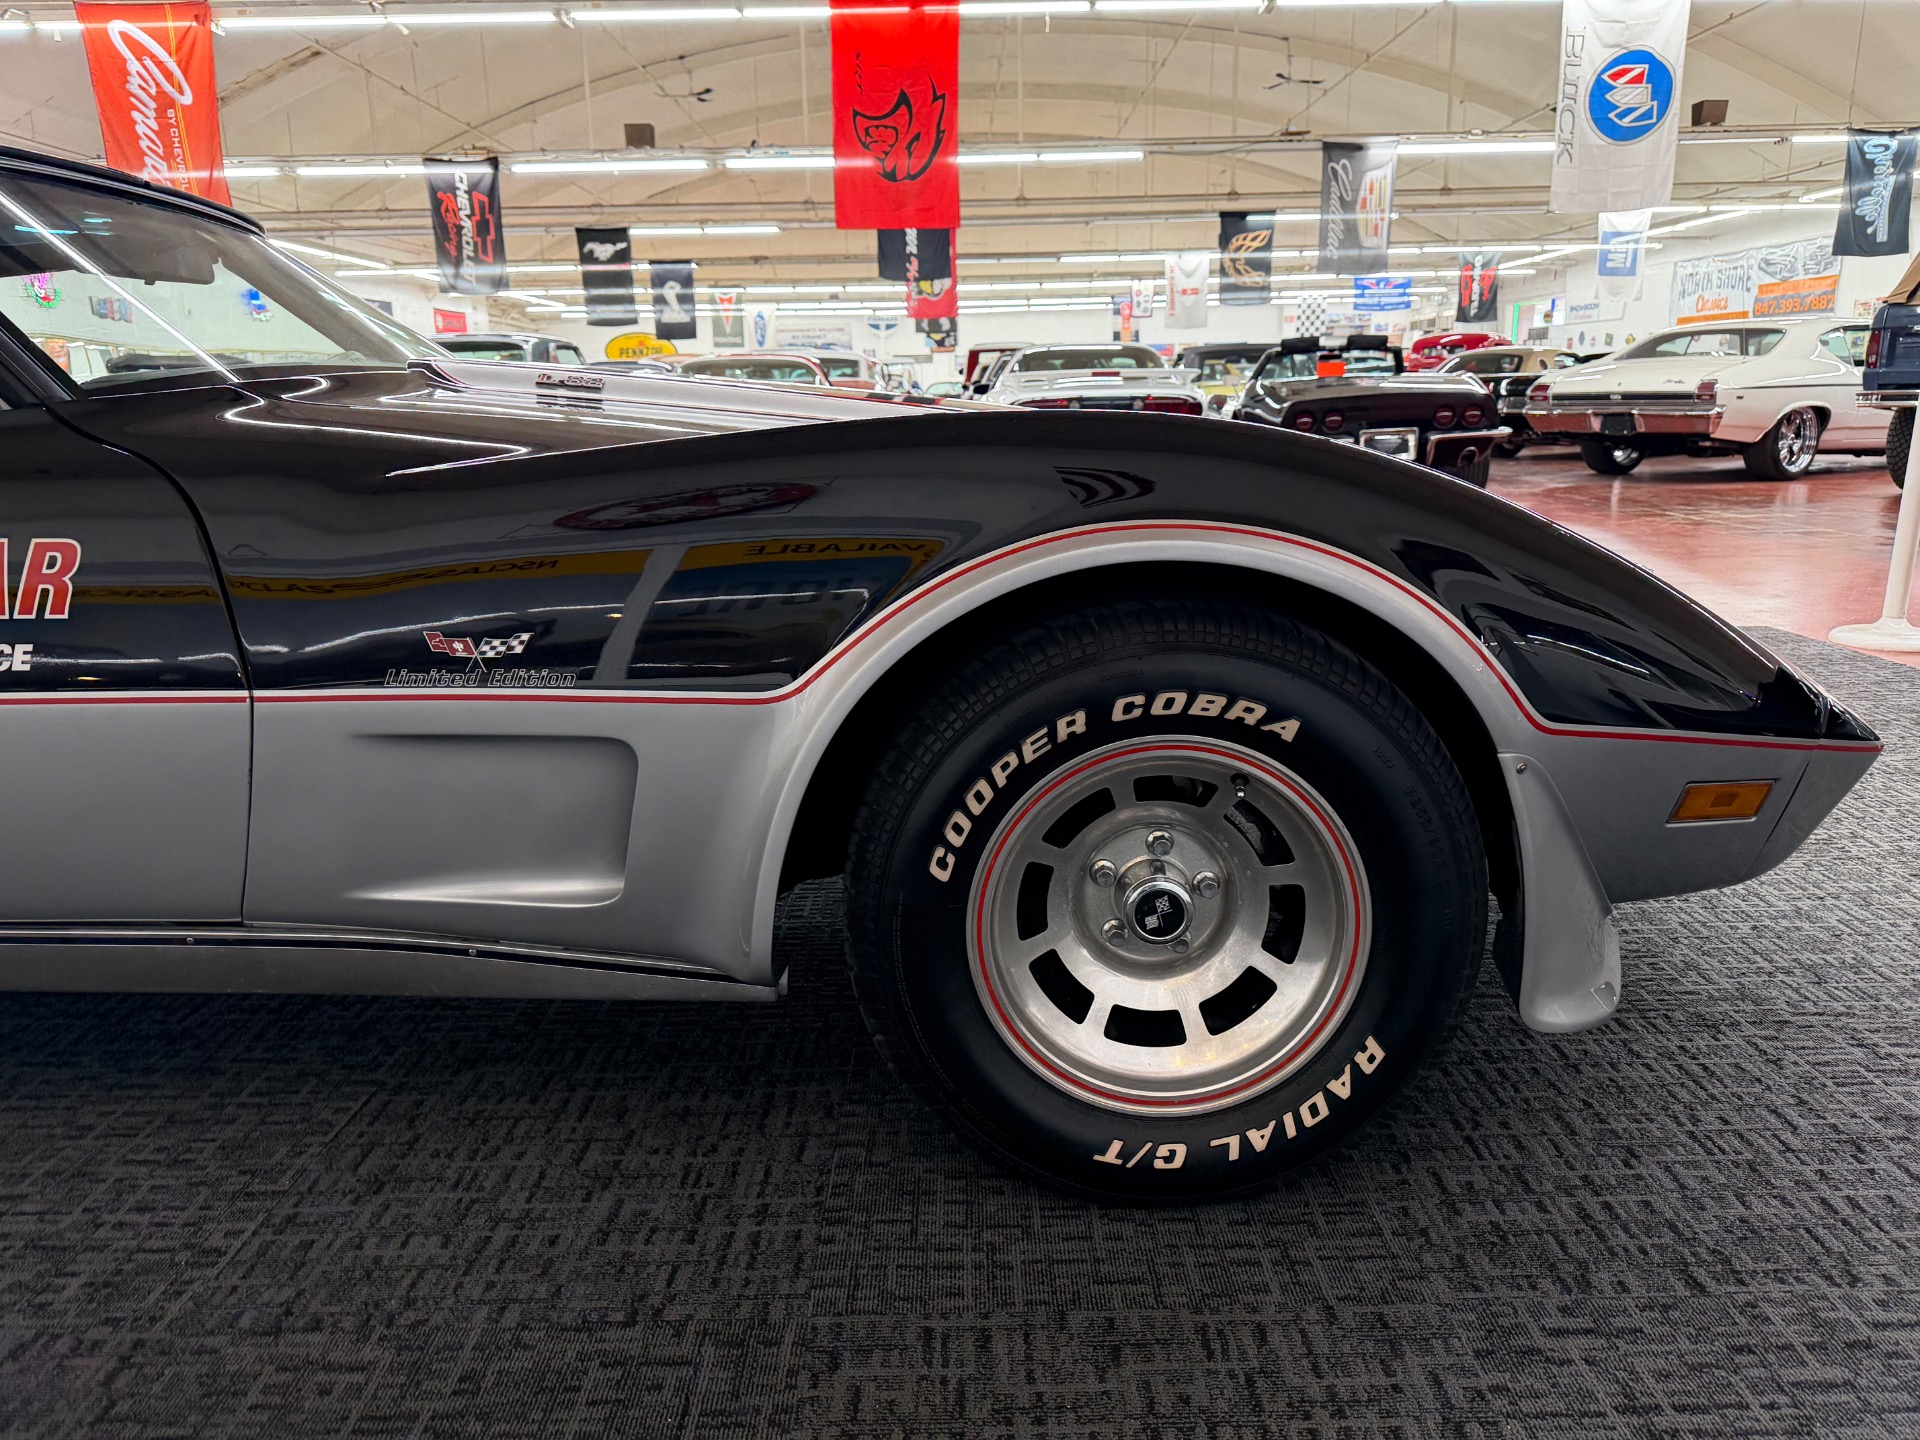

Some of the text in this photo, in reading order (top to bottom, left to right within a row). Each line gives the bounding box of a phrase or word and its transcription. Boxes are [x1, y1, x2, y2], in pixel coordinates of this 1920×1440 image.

[1556, 25, 1587, 165] BUICK
[167, 108, 191, 191] BY CHEVROL
[454, 170, 477, 287] CHEVROLET
[1327, 158, 1353, 260] Cadillac
[1678, 270, 1713, 302] NORTH
[1716, 263, 1752, 293] SHORE
[384, 668, 577, 687] Limited Edition
[928, 691, 1302, 883] COOPER COBRA
[1210, 1035, 1386, 1162] RADIAL
[1092, 1139, 1188, 1170] G/T
